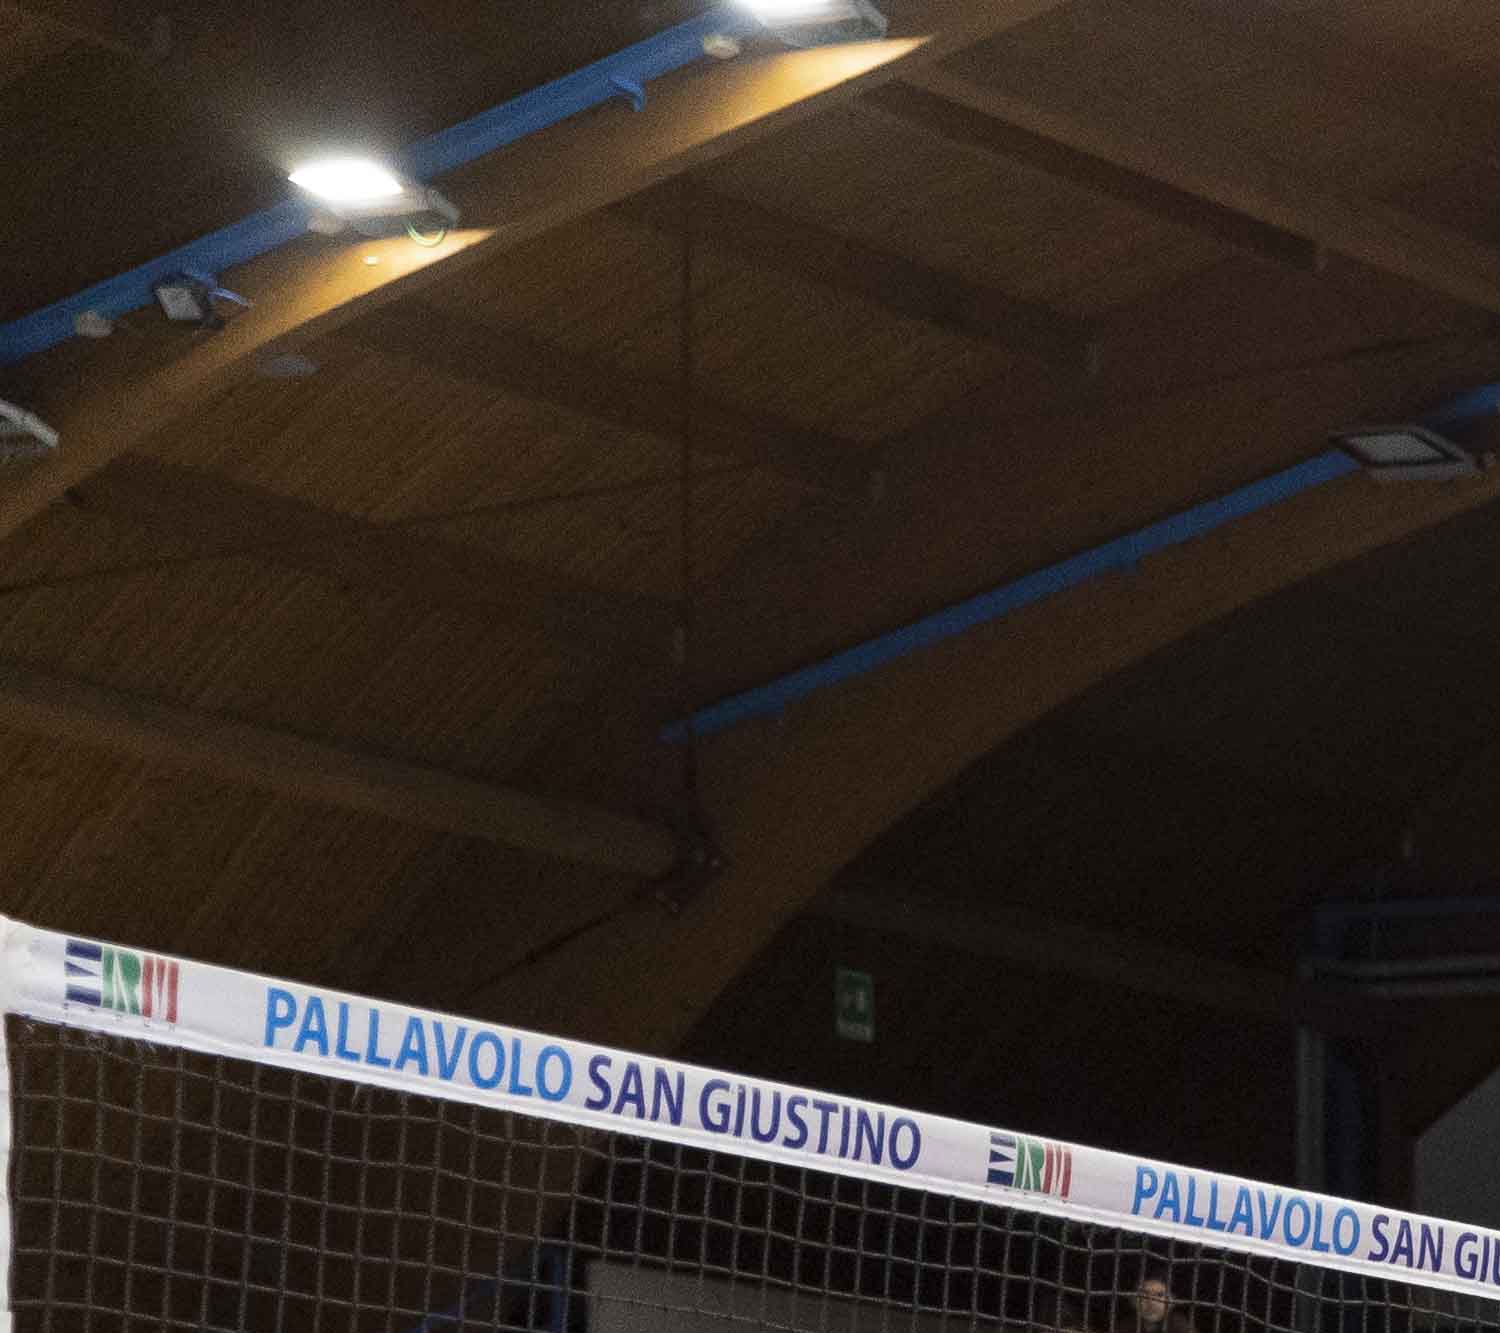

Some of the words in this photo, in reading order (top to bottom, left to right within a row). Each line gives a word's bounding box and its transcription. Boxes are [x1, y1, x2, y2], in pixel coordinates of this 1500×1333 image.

[264, 986, 572, 1101] PALLAVOLO
[585, 1054, 685, 1126] SAN
[699, 1077, 922, 1171] GIUSTINO
[1133, 1165, 1362, 1257] PALLAVOLO
[1367, 1214, 1444, 1274] SAN
